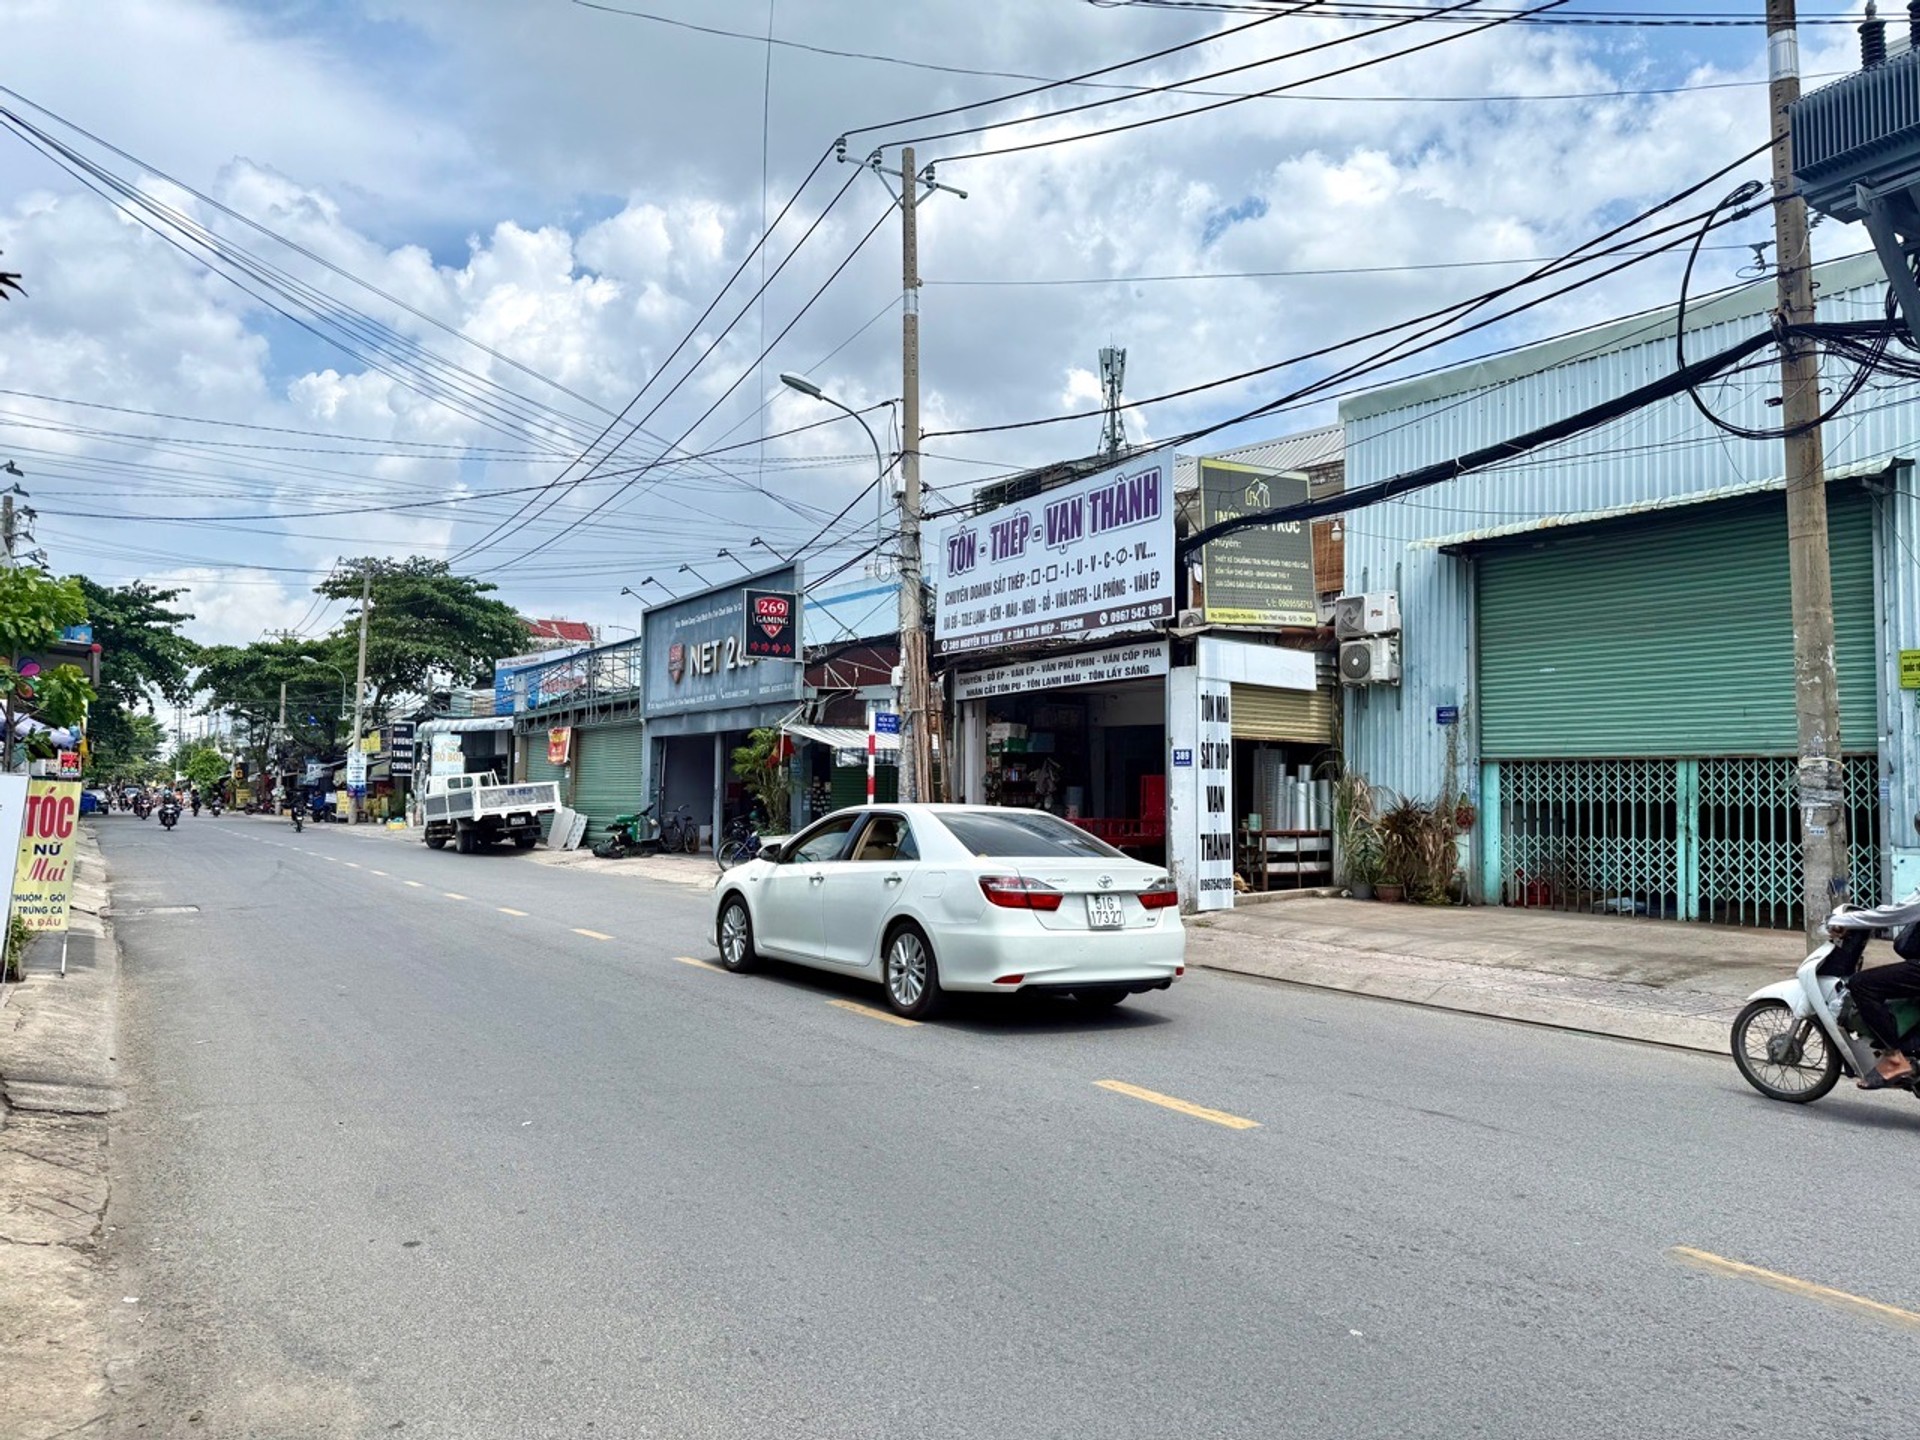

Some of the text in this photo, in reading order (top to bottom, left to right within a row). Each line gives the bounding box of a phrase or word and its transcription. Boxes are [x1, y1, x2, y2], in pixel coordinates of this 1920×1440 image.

[948, 473, 1159, 574] TÔN THÉP VẠN THÀNH
[945, 585, 969, 606] CHUYÊN
[970, 581, 993, 601] DOANH
[993, 573, 1006, 595] SẮT
[1008, 570, 1026, 592] THÉP
[1055, 588, 1067, 608] VÁN
[1093, 583, 1101, 601] LA
[1134, 571, 1149, 592] VÁN
[1150, 568, 1160, 589] ÉP
[756, 615, 788, 624] GAMING
[760, 601, 785, 614] 269
[1110, 603, 1163, 623] 0967 542 199
[689, 639, 722, 677] NET
[996, 670, 1005, 680] ÉP
[1011, 668, 1024, 678] VÁN
[1026, 665, 1035, 676] ÉP
[1041, 661, 1057, 673] VÁN
[1058, 657, 1073, 670] PHỦ
[1075, 656, 1095, 668] PHIN
[1102, 652, 1120, 664] VÁN
[1122, 648, 1140, 661] CỐP
[1142, 647, 1162, 659] PHA
[984, 683, 996, 695] CẮT
[997, 682, 1010, 693] TÔN
[1011, 681, 1021, 691] PU
[1026, 679, 1041, 688] TÔN
[1042, 675, 1062, 689] LẠNH
[1063, 672, 1081, 684] MÀU
[1088, 669, 1104, 681] TÔN
[1124, 664, 1150, 676] SÁNG
[1200, 734, 1214, 769] SẮT
[26, 786, 75, 839] TÓC
[1206, 785, 1225, 819] VẠN
[33, 841, 63, 856] NỮ
[1200, 829, 1231, 861] THÀNH
[23, 857, 68, 882] Mai
[1095, 896, 1114, 910] 51G
